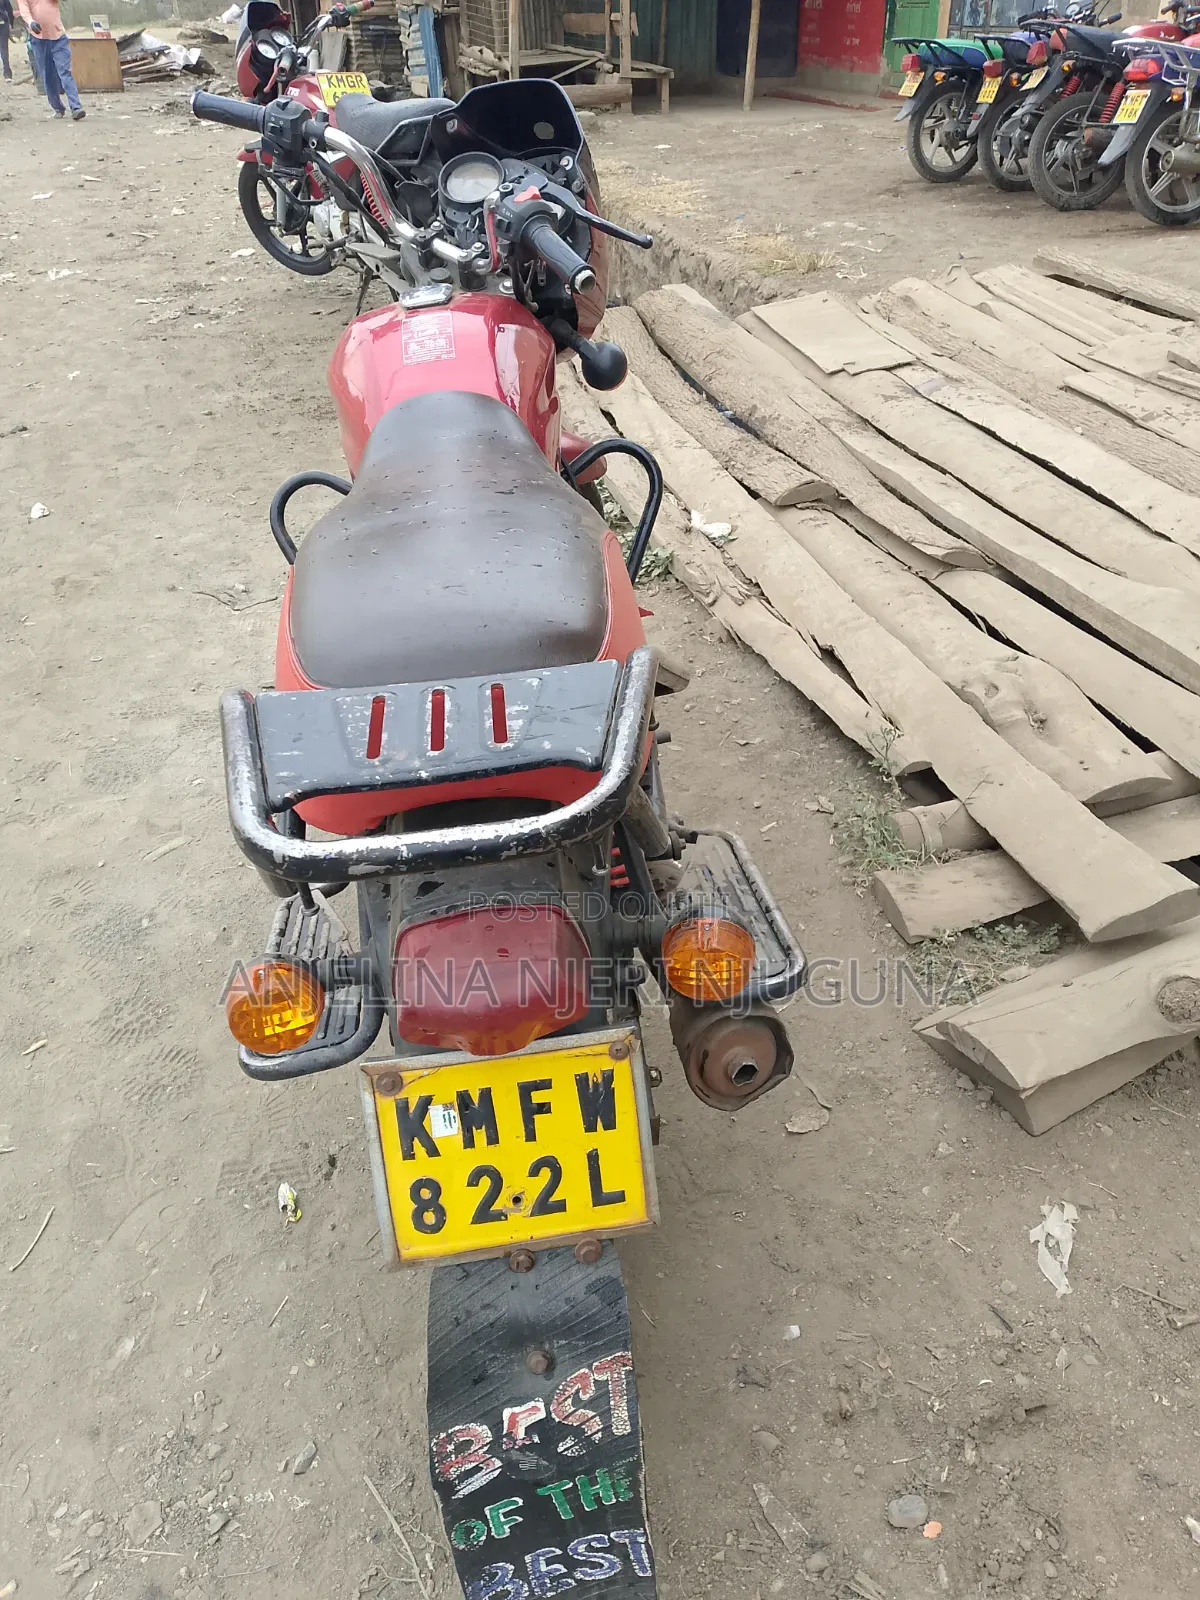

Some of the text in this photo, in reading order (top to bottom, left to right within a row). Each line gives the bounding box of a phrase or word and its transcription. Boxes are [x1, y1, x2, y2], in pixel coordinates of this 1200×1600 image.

[326, 74, 365, 88] KMGR
[394, 1069, 618, 1161] KMFW
[409, 1148, 627, 1235] 822L
[431, 1351, 633, 1500] BEST
[451, 1497, 524, 1550] OF
[464, 1527, 652, 1600] BEST
